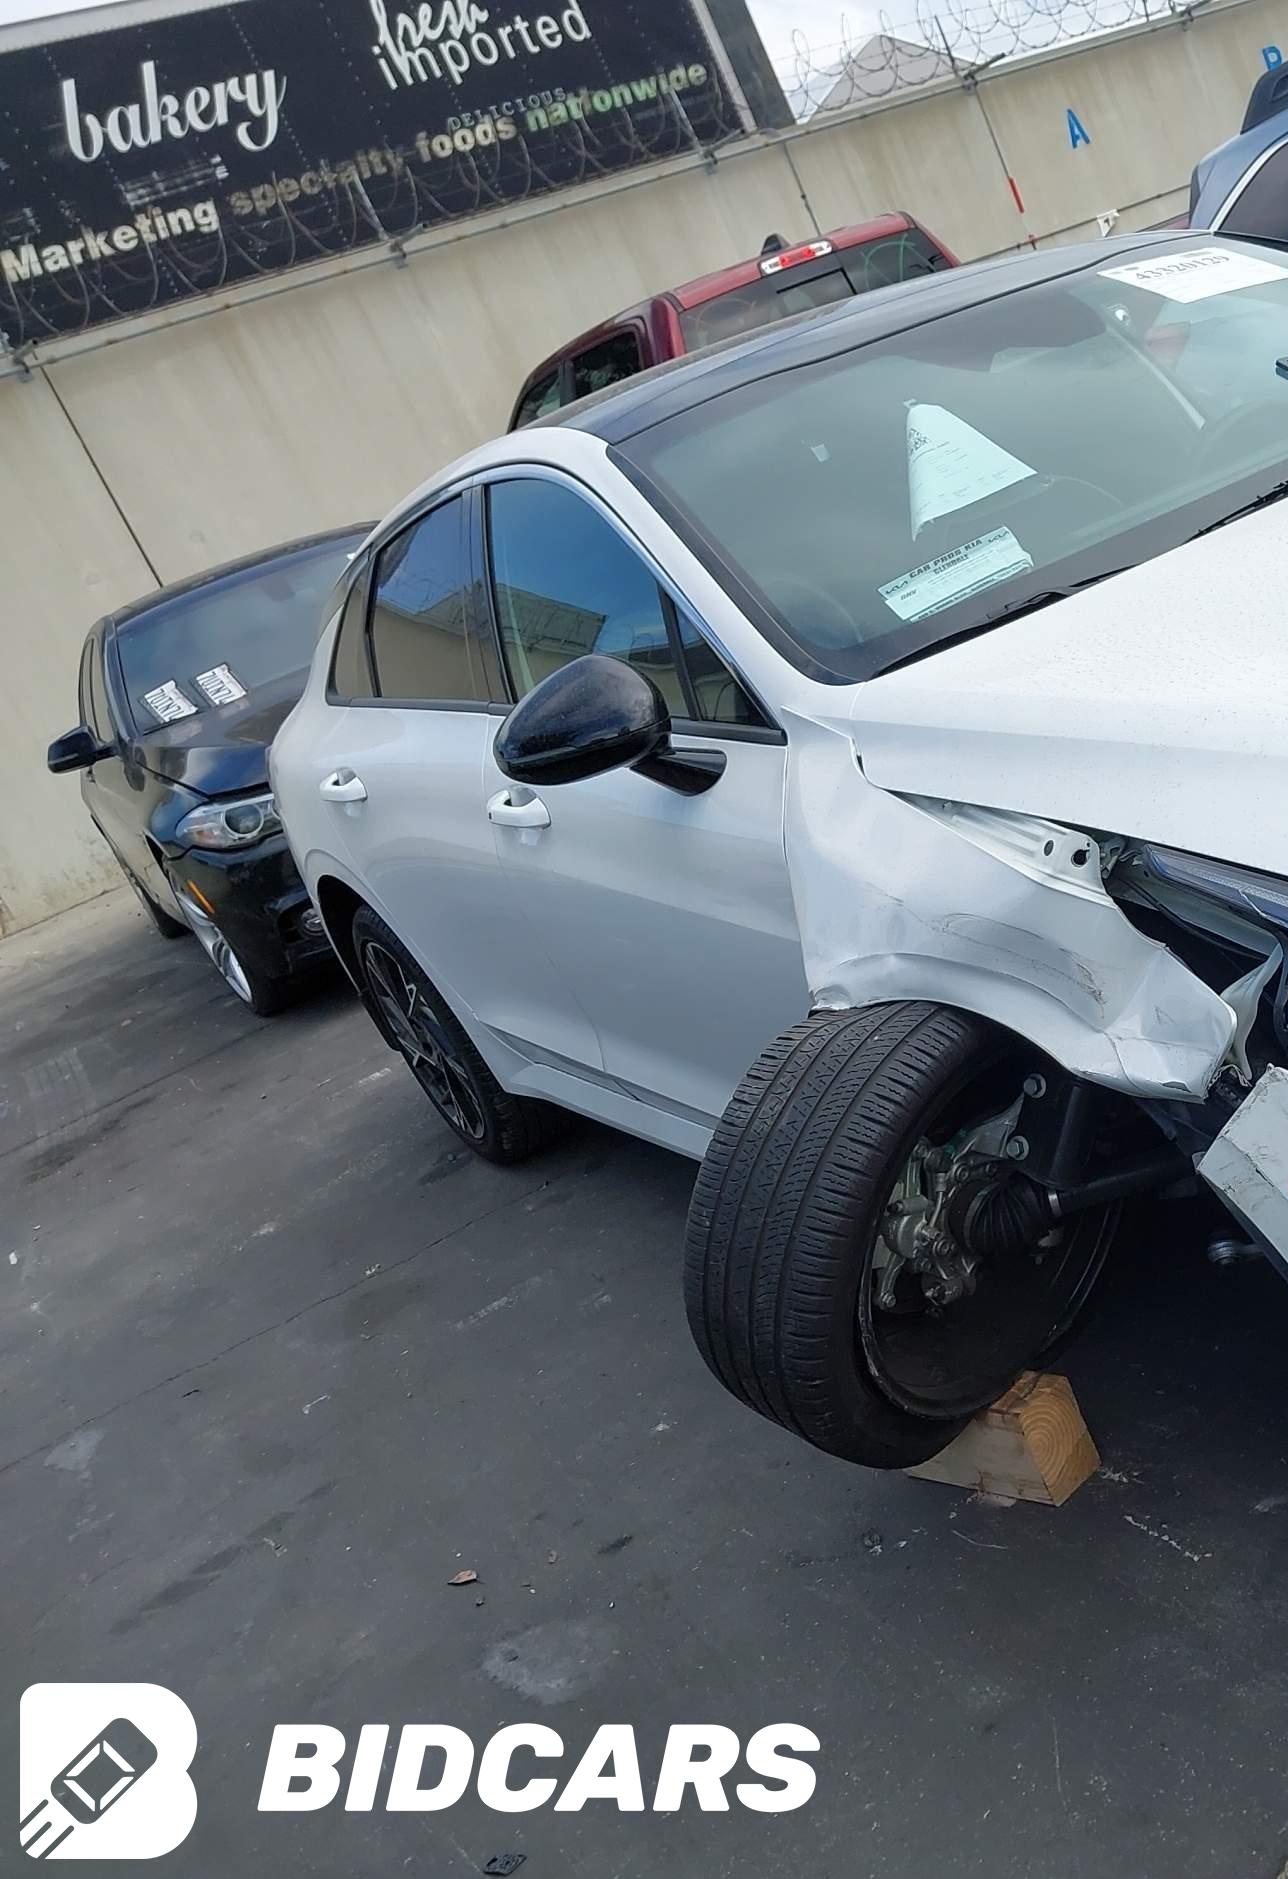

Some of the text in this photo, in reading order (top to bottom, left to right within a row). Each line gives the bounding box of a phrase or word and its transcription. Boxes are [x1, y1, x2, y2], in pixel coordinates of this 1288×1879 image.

[371, 0, 592, 90] imported
[62, 60, 287, 163] bakery
[449, 86, 569, 131] DELICIOUS
[1067, 108, 1090, 149] A
[0, 199, 220, 283] Marketing
[415, 114, 518, 163] foods
[525, 62, 708, 132] nationwide
[909, 563, 931, 579] CAR
